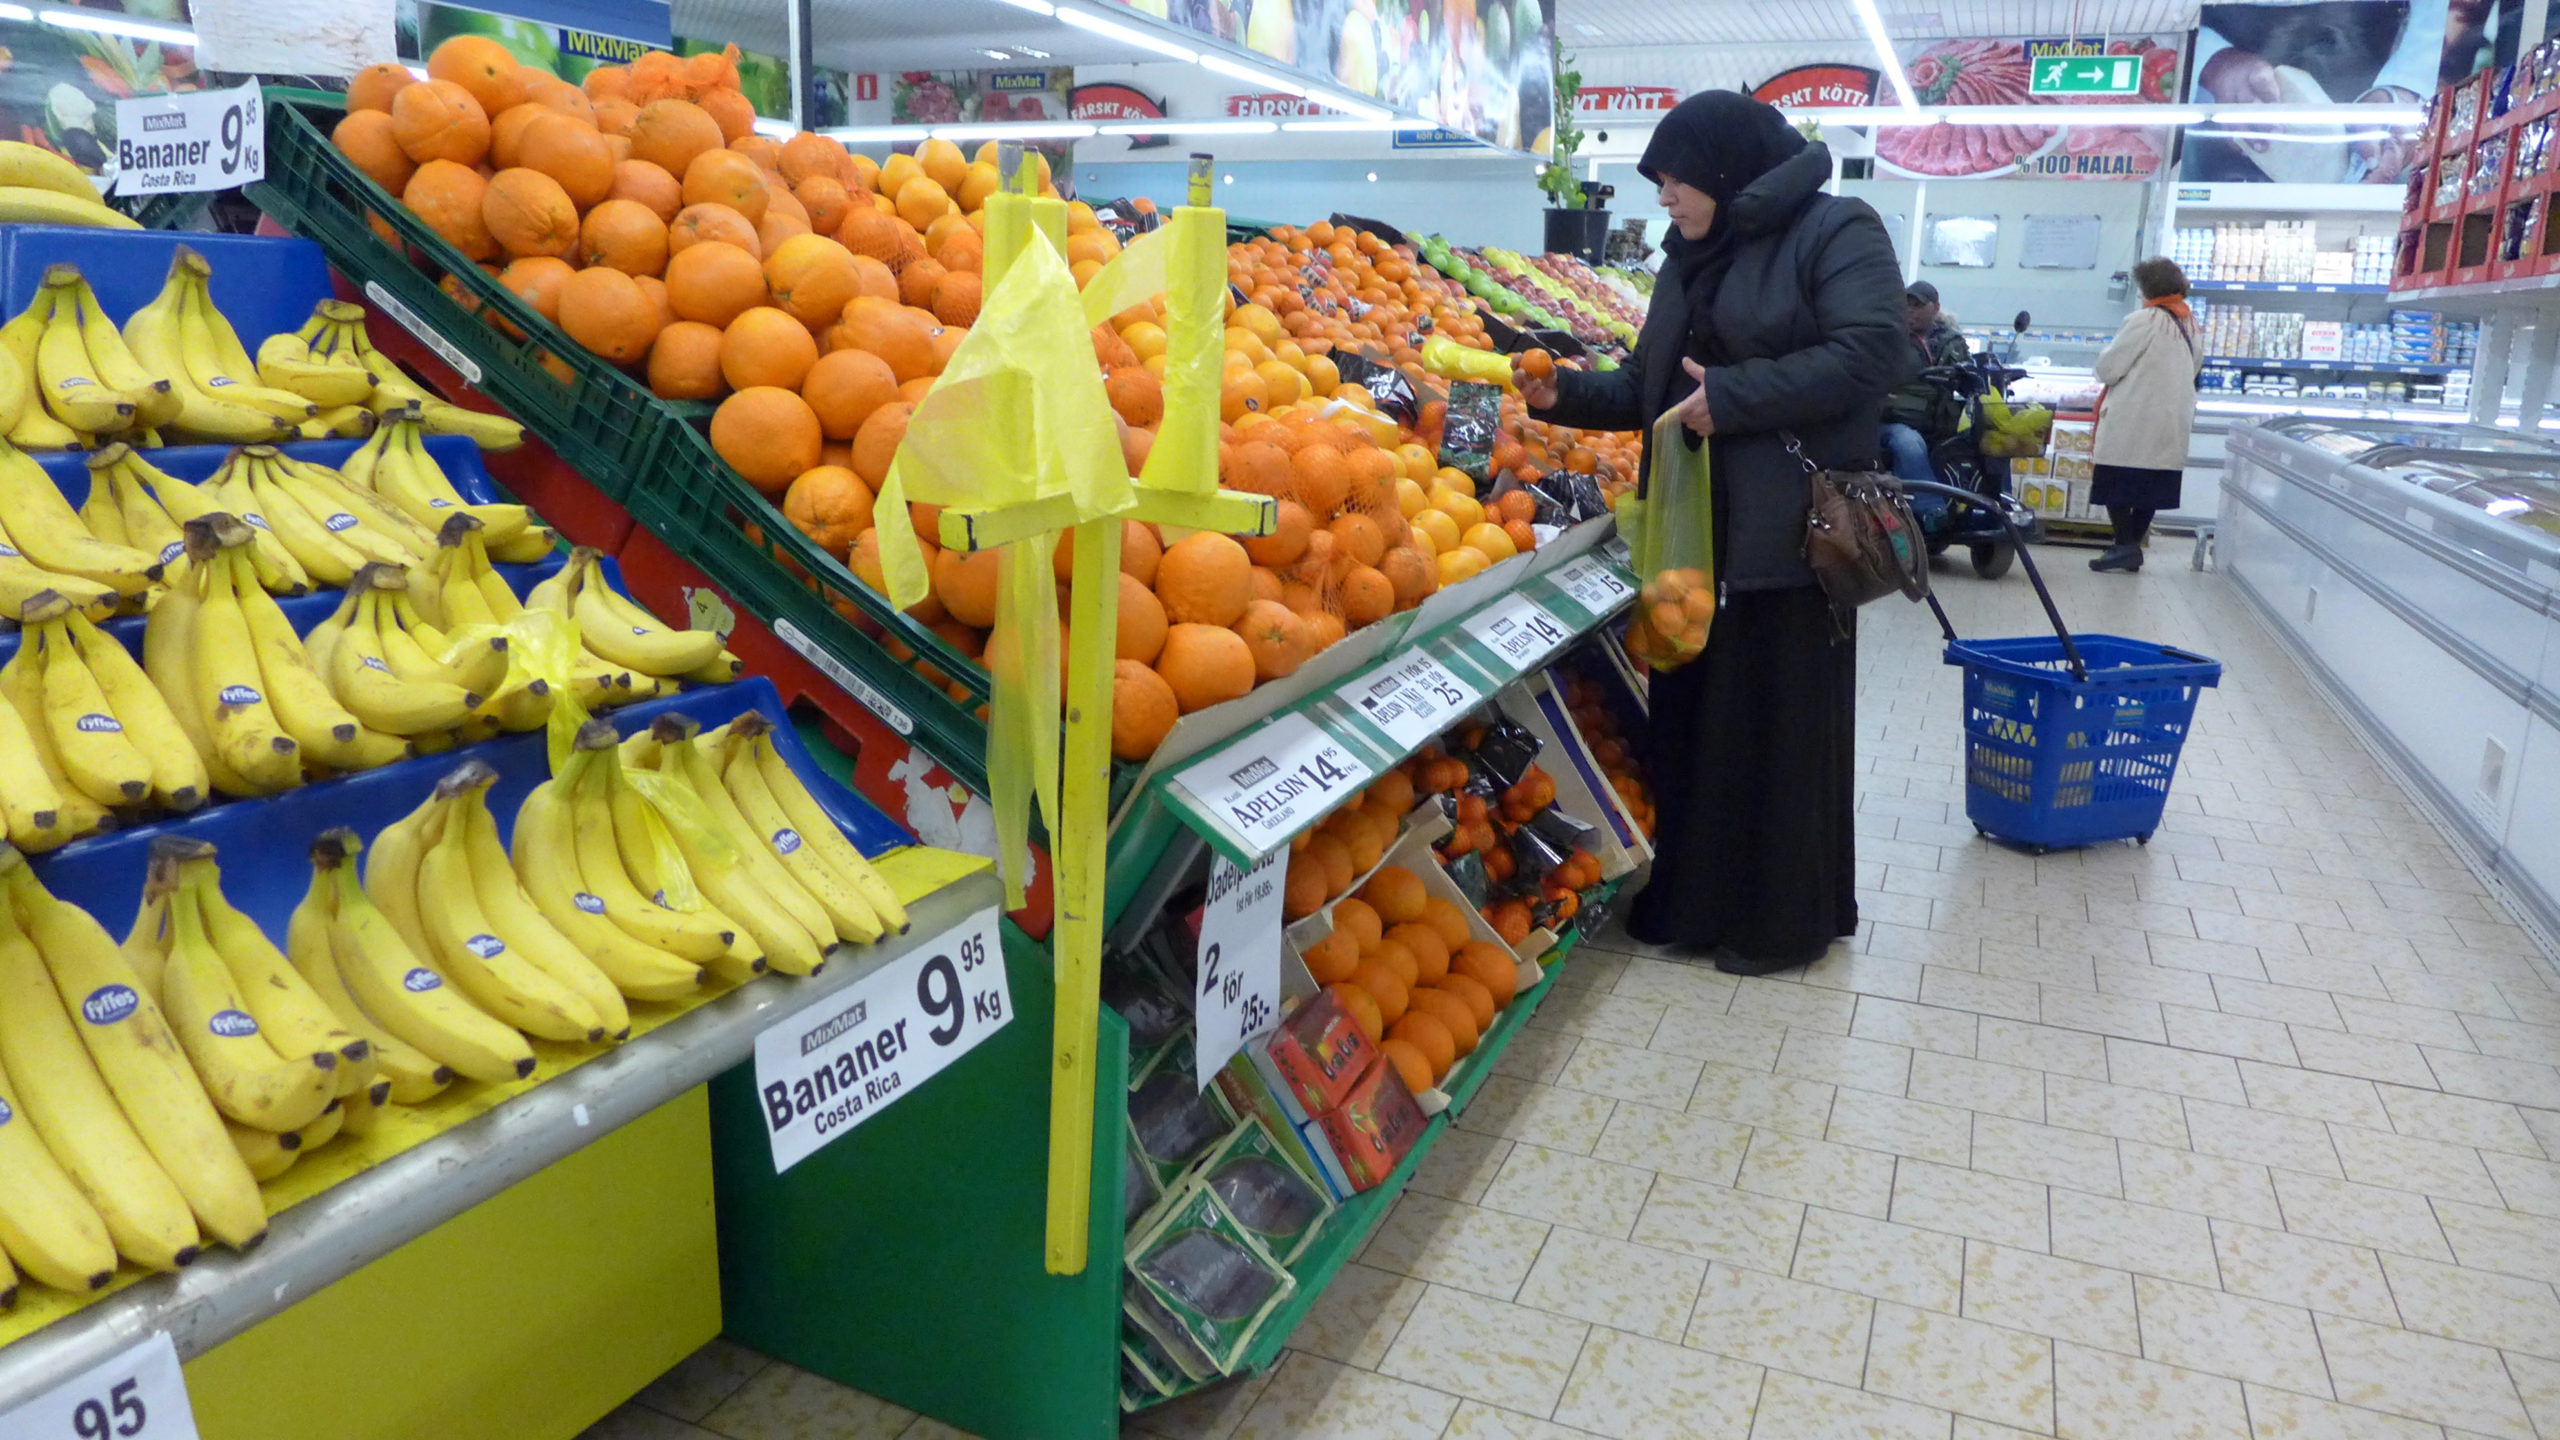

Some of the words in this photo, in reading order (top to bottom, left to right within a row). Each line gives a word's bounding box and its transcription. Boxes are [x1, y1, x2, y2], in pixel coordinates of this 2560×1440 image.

[2031, 41, 2101, 55] MixMat
[996, 75, 1041, 89] MixMat
[1769, 87, 1812, 109] RSKT
[1819, 82, 1869, 107] KÖTT!
[246, 98, 256, 126] 95
[1071, 101, 1119, 120] FÄRSKT
[120, 139, 210, 171] Bananer
[221, 104, 242, 174] 9
[244, 145, 259, 173] Kg
[2015, 154, 2031, 175] %
[2037, 154, 2071, 174] 100
[141, 173, 170, 188] Costa
[173, 171, 196, 186] Rica
[1600, 575, 1625, 595] 15
[1526, 616, 1564, 646] 14
[1433, 681, 1463, 706] 25
[1322, 747, 1338, 760] 95
[1235, 756, 1277, 788] MixMat
[1299, 754, 1348, 792] 14
[1231, 773, 1310, 829] APELSIN
[961, 933, 985, 972] 95
[1203, 942, 1220, 996] 2
[917, 954, 965, 1047] 9
[1223, 970, 1244, 1009] för
[973, 989, 1002, 1024] Kg
[1240, 993, 1270, 1039] 25:-
[805, 1004, 866, 1051] MixMat
[763, 1017, 908, 1133] Bananer
[814, 1095, 863, 1135] Costa
[865, 1071, 902, 1105] Rica
[73, 1376, 146, 1440] 95
